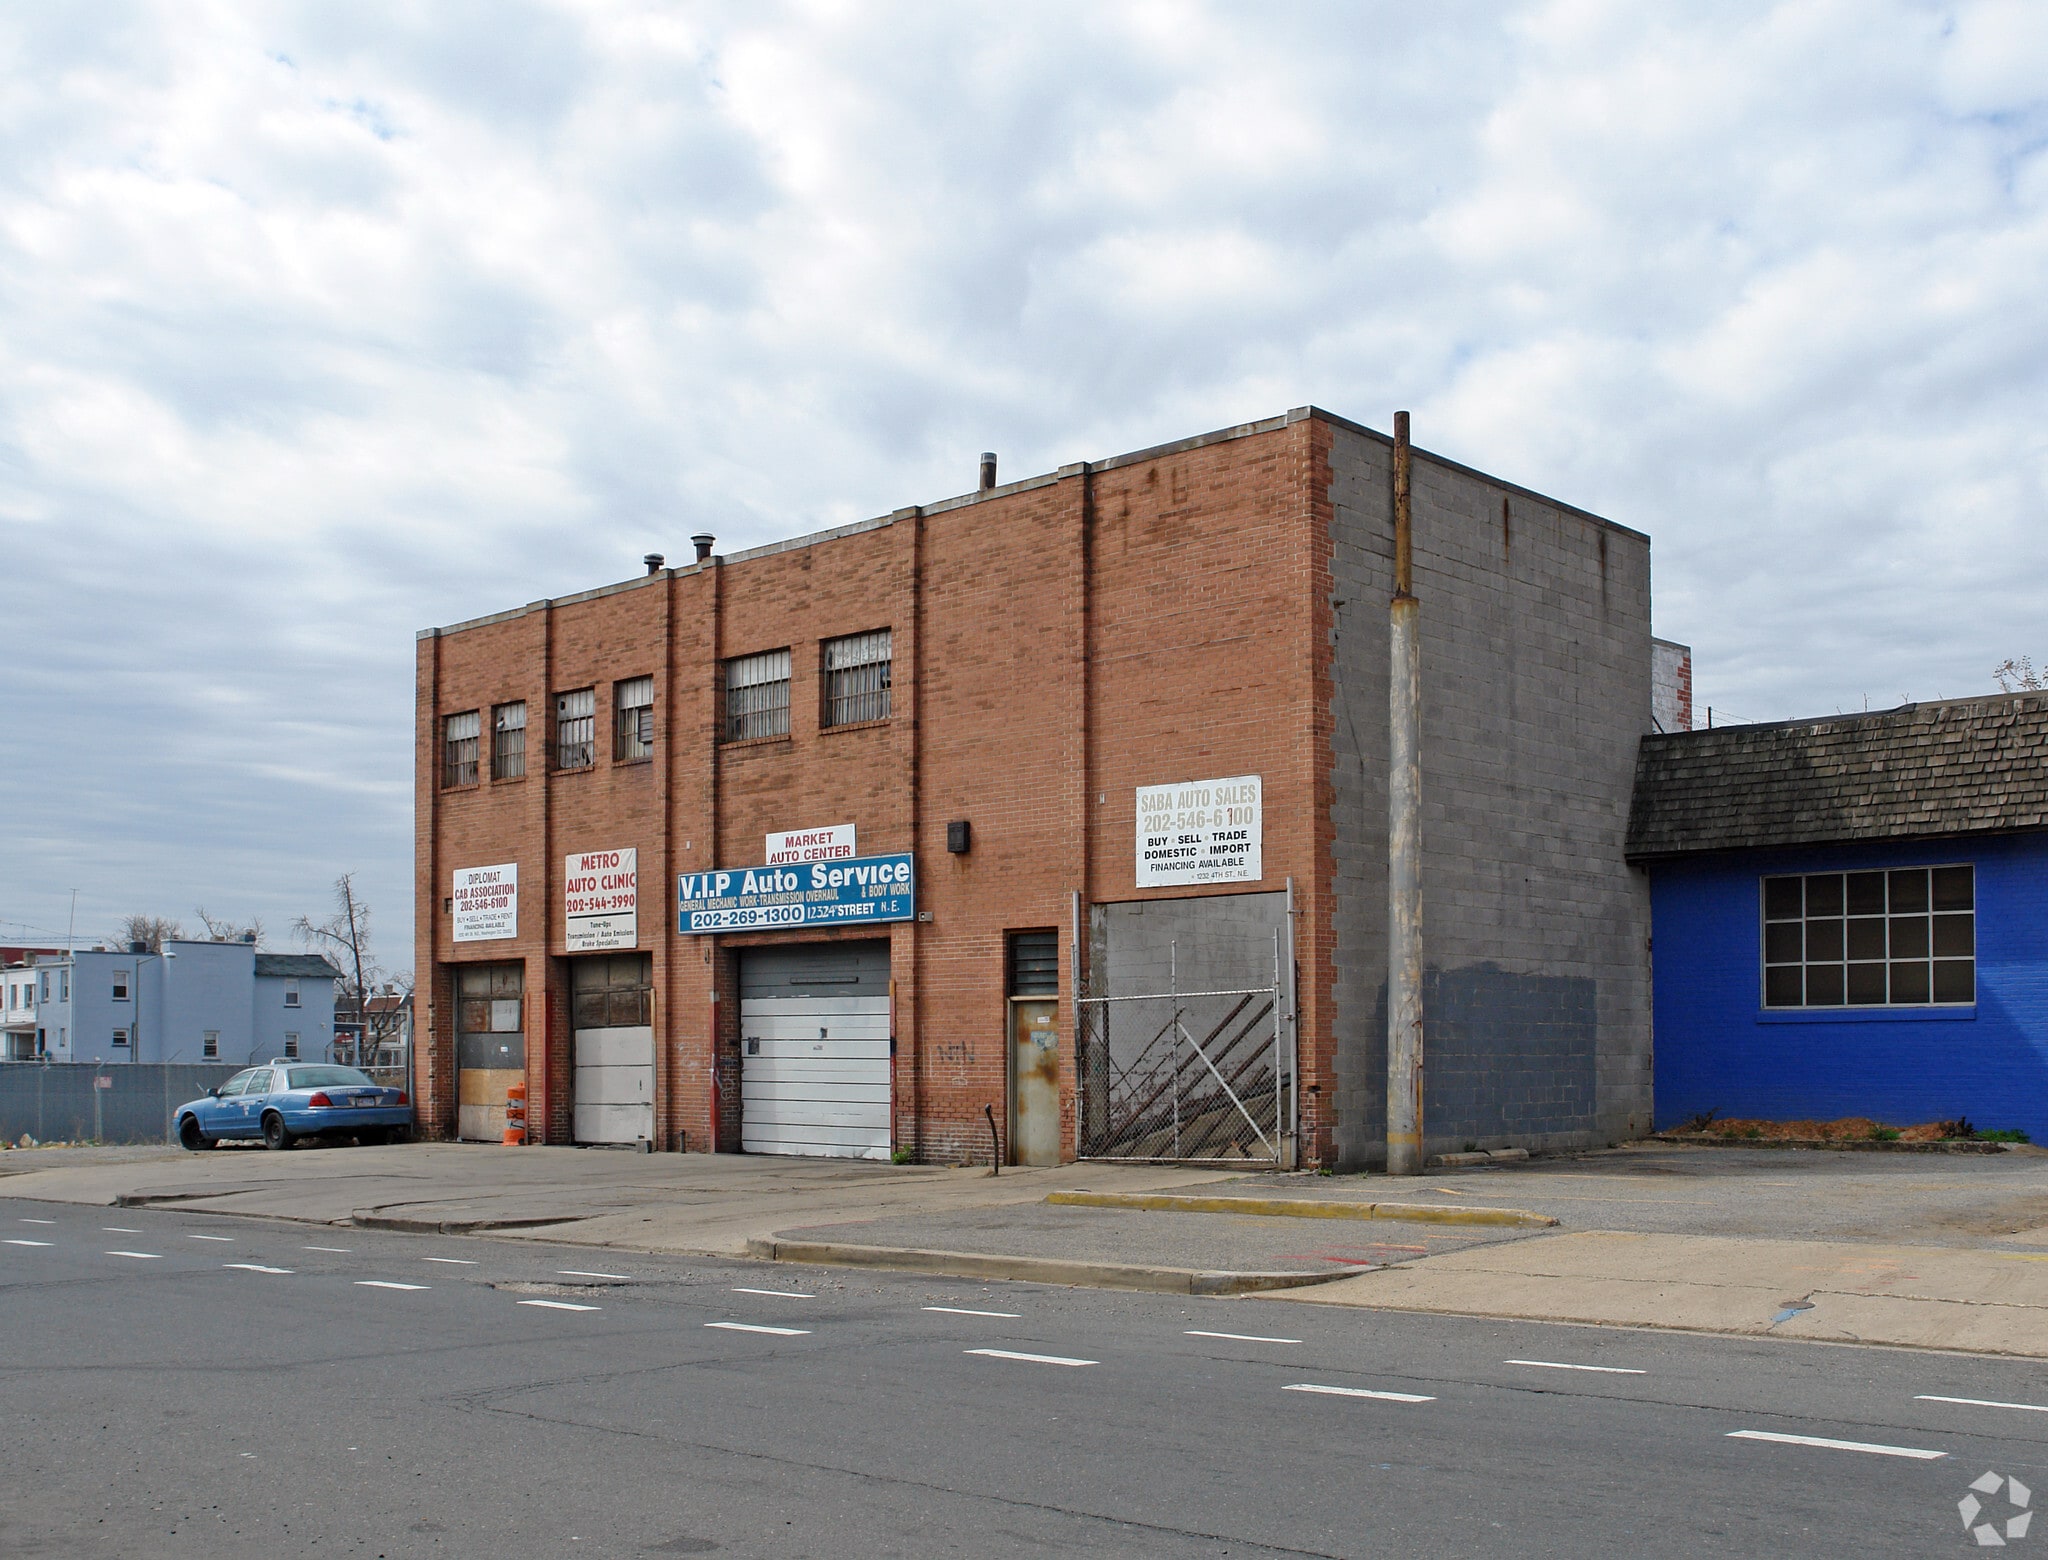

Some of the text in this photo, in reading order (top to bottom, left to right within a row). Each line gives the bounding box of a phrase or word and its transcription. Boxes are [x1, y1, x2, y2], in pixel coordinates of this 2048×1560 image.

[1141, 784, 1256, 813] SABA AUTO SALES
[785, 832, 834, 848] MARKET
[1148, 830, 1248, 847] BUY SELL TRADE
[770, 845, 851, 864] AUTO CENTER
[1144, 843, 1251, 860] DOMESTIC IMPORT
[580, 852, 620, 871] METRO
[1150, 857, 1245, 872] FINANCING AVAILABLE
[468, 871, 501, 885] DIPLOMAT
[567, 872, 636, 894] AUTO CLINIC
[680, 862, 910, 900] V.I.P Auto Service
[455, 883, 515, 900] CAB ASSOCIATION
[680, 900, 706, 912] GENERAL
[707, 896, 738, 910] MECHANIC
[806, 888, 840, 902] OVERHAUL
[861, 886, 867, 898] &
[869, 884, 889, 897] BODY
[890, 882, 911, 896] WORK
[460, 896, 508, 912] 202-546-6100
[567, 894, 635, 913] 202-544-3990
[694, 907, 801, 928] 202-269-1300
[838, 902, 875, 917] STREET
